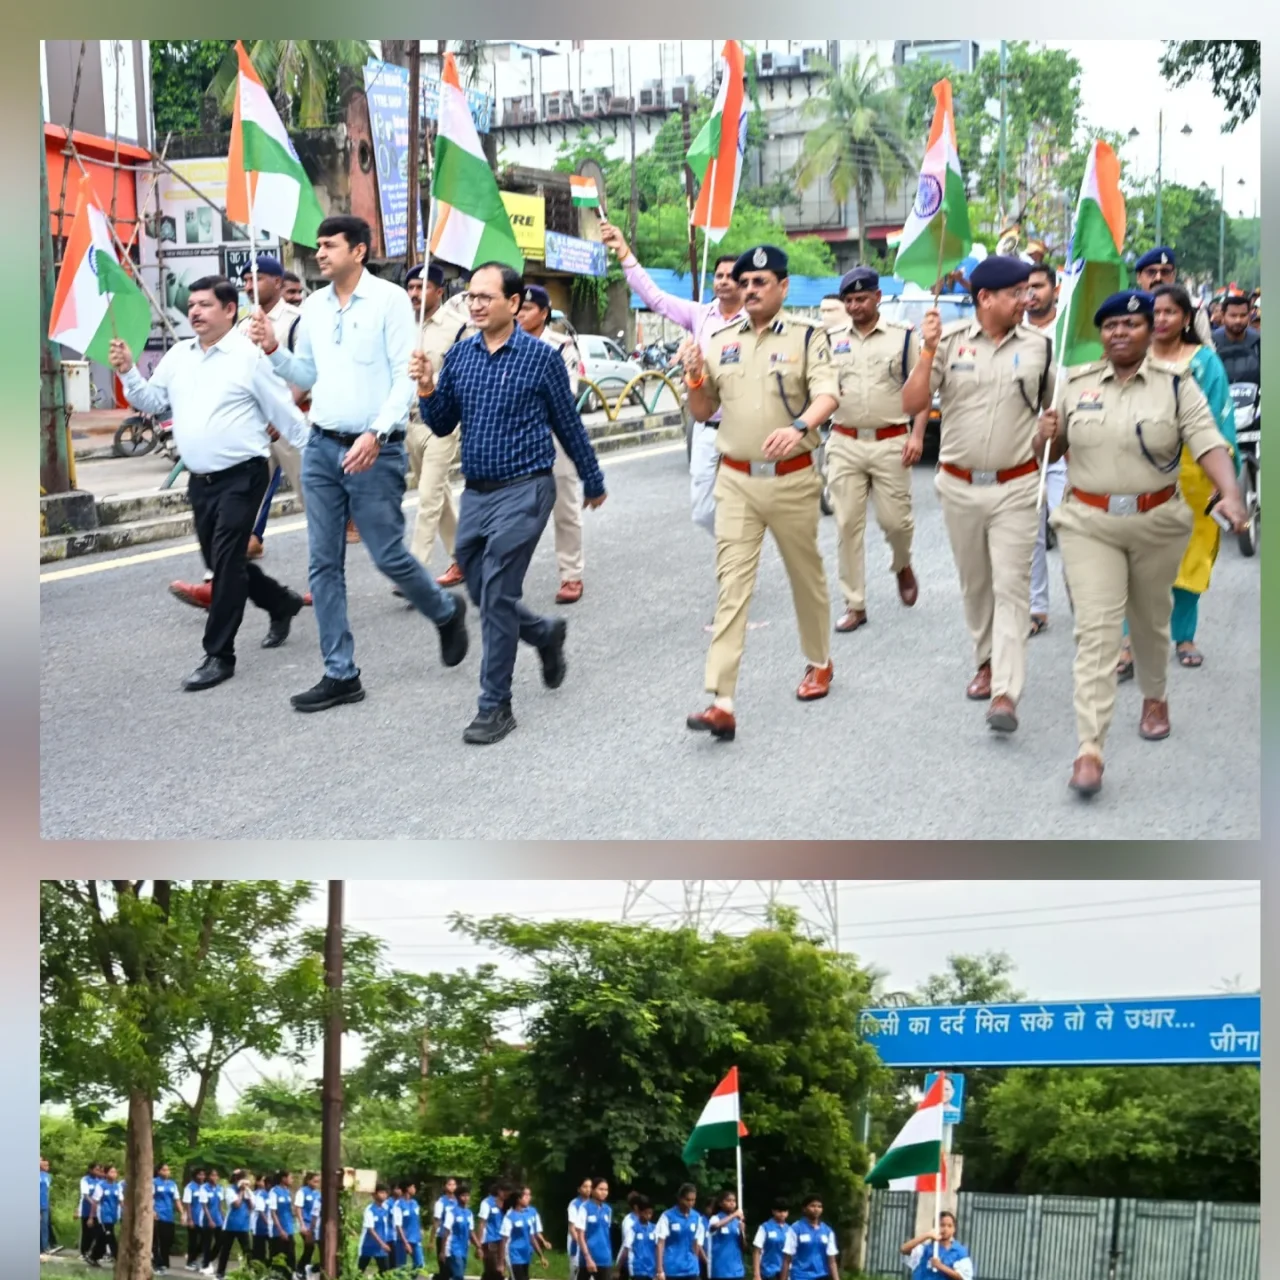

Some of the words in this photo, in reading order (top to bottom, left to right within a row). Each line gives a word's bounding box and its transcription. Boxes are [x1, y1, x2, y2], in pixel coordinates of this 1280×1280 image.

[908, 1016, 931, 1035] का
[940, 1008, 966, 1035] दर्द
[975, 1008, 1010, 1034] मिल
[1019, 1006, 1055, 1032] सके
[1064, 1004, 1085, 1031] तो
[1095, 1003, 1114, 1030] ले
[1209, 1023, 1260, 1052] जीना
